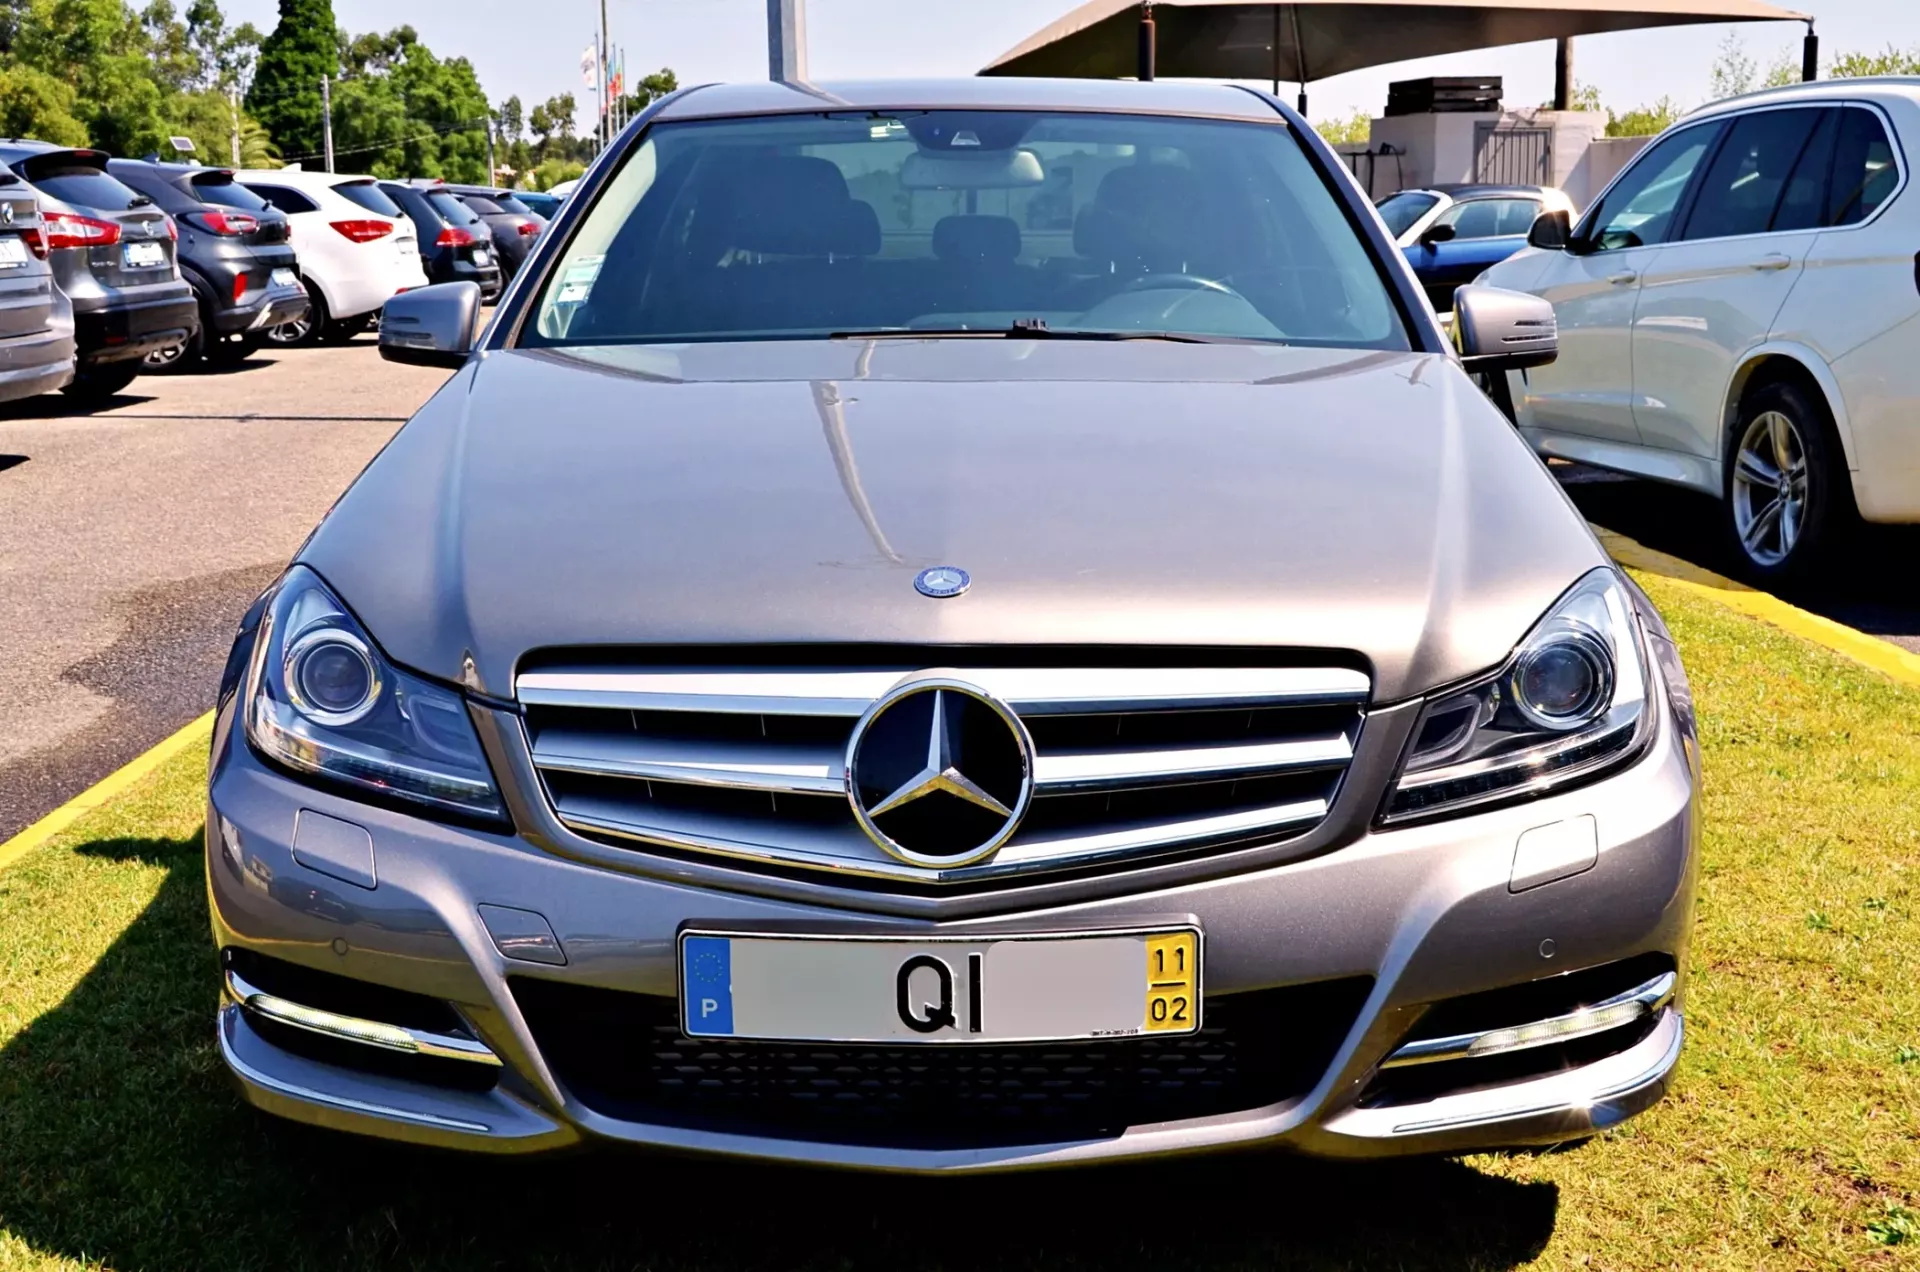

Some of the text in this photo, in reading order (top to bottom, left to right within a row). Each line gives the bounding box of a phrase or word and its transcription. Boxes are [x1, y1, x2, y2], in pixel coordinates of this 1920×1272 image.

[1156, 947, 1184, 972] 11
[896, 954, 982, 1033] QI
[702, 998, 718, 1018] P
[1151, 996, 1187, 1022] 02
